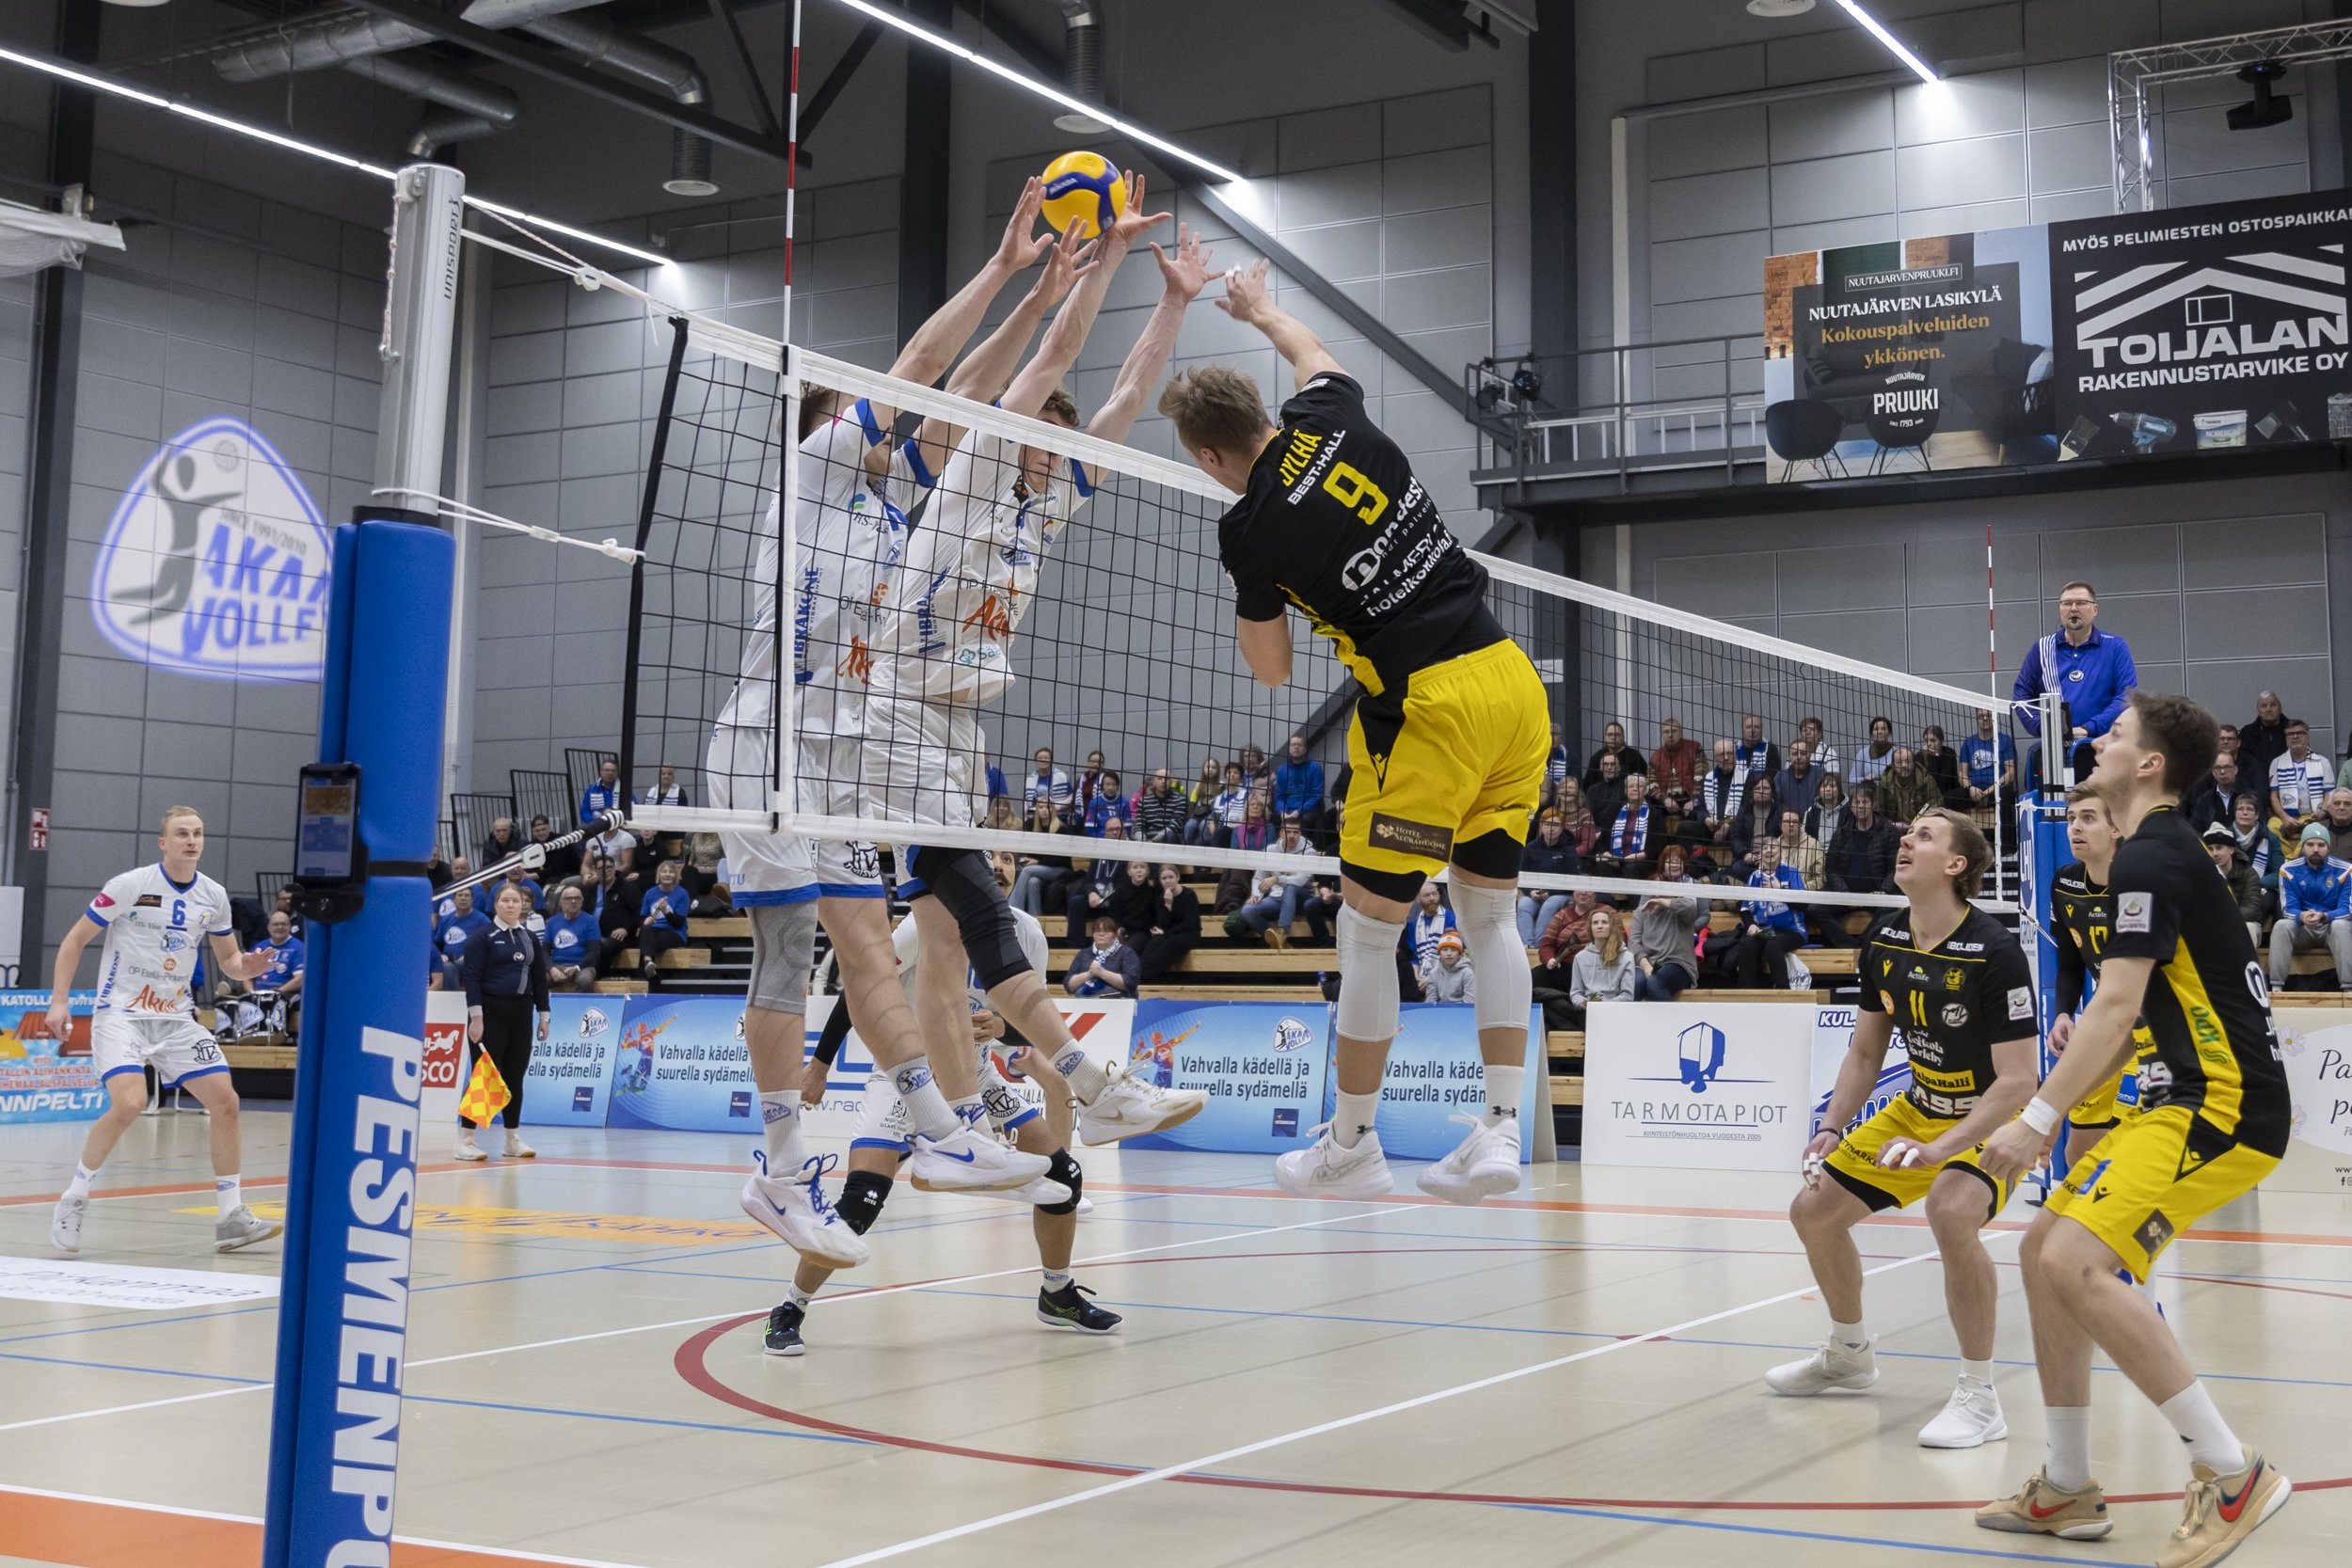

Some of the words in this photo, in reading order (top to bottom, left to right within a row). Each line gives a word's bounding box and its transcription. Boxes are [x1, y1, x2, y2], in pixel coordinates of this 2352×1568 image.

[2062, 234, 2108, 252] MYÖS
[2114, 223, 2223, 246] PELIMIESTEN
[2229, 207, 2352, 233] OSTOSPAIKKA!
[444, 209, 459, 300] UNISPORT
[1848, 269, 1959, 288] NUUTAJARVENPRUUKI.FI
[1809, 295, 1921, 321] NUUTAJÄRVEN
[1925, 286, 2002, 309] LASIKYLÄ
[1821, 314, 1991, 344] Kokouspalveluiden
[2077, 314, 2348, 369] TOIJALAN
[1864, 347, 1946, 369] ykkönen.
[2078, 356, 2310, 393] RAKENNUSTARVIKE
[2315, 351, 2349, 371] OY
[1884, 372, 1925, 385] NUUTAJÄRVEN
[1873, 388, 1939, 415] PRUUKI
[1278, 429, 1322, 487] JYLHÄ
[1287, 430, 1346, 505] BEST-HALL
[1323, 461, 1389, 525] 9
[183, 595, 317, 660] VOLLE
[171, 899, 186, 927] 6
[2090, 926, 2107, 955] 17
[1909, 990, 1928, 1026] 11
[2189, 1006, 2221, 1044] KPO
[554, 1042, 592, 1059] kädellä
[595, 1043, 605, 1063] ja
[660, 1044, 705, 1062] Vahvalla
[708, 1044, 749, 1064] kädellä
[2319, 1049, 2352, 1081] Pa
[548, 1063, 602, 1081] sydämellä
[656, 1066, 699, 1081] suurella
[1182, 1055, 1237, 1075] Vahvalla
[1242, 1057, 1292, 1077] kädellä
[1295, 1058, 1310, 1080] ja
[1385, 1060, 1443, 1080] Vahvalla
[1449, 1061, 1484, 1081] käde
[0, 1091, 104, 1113] NNPELTI
[1237, 1080, 1308, 1103] sydämellä
[1381, 1084, 1438, 1103] suurella
